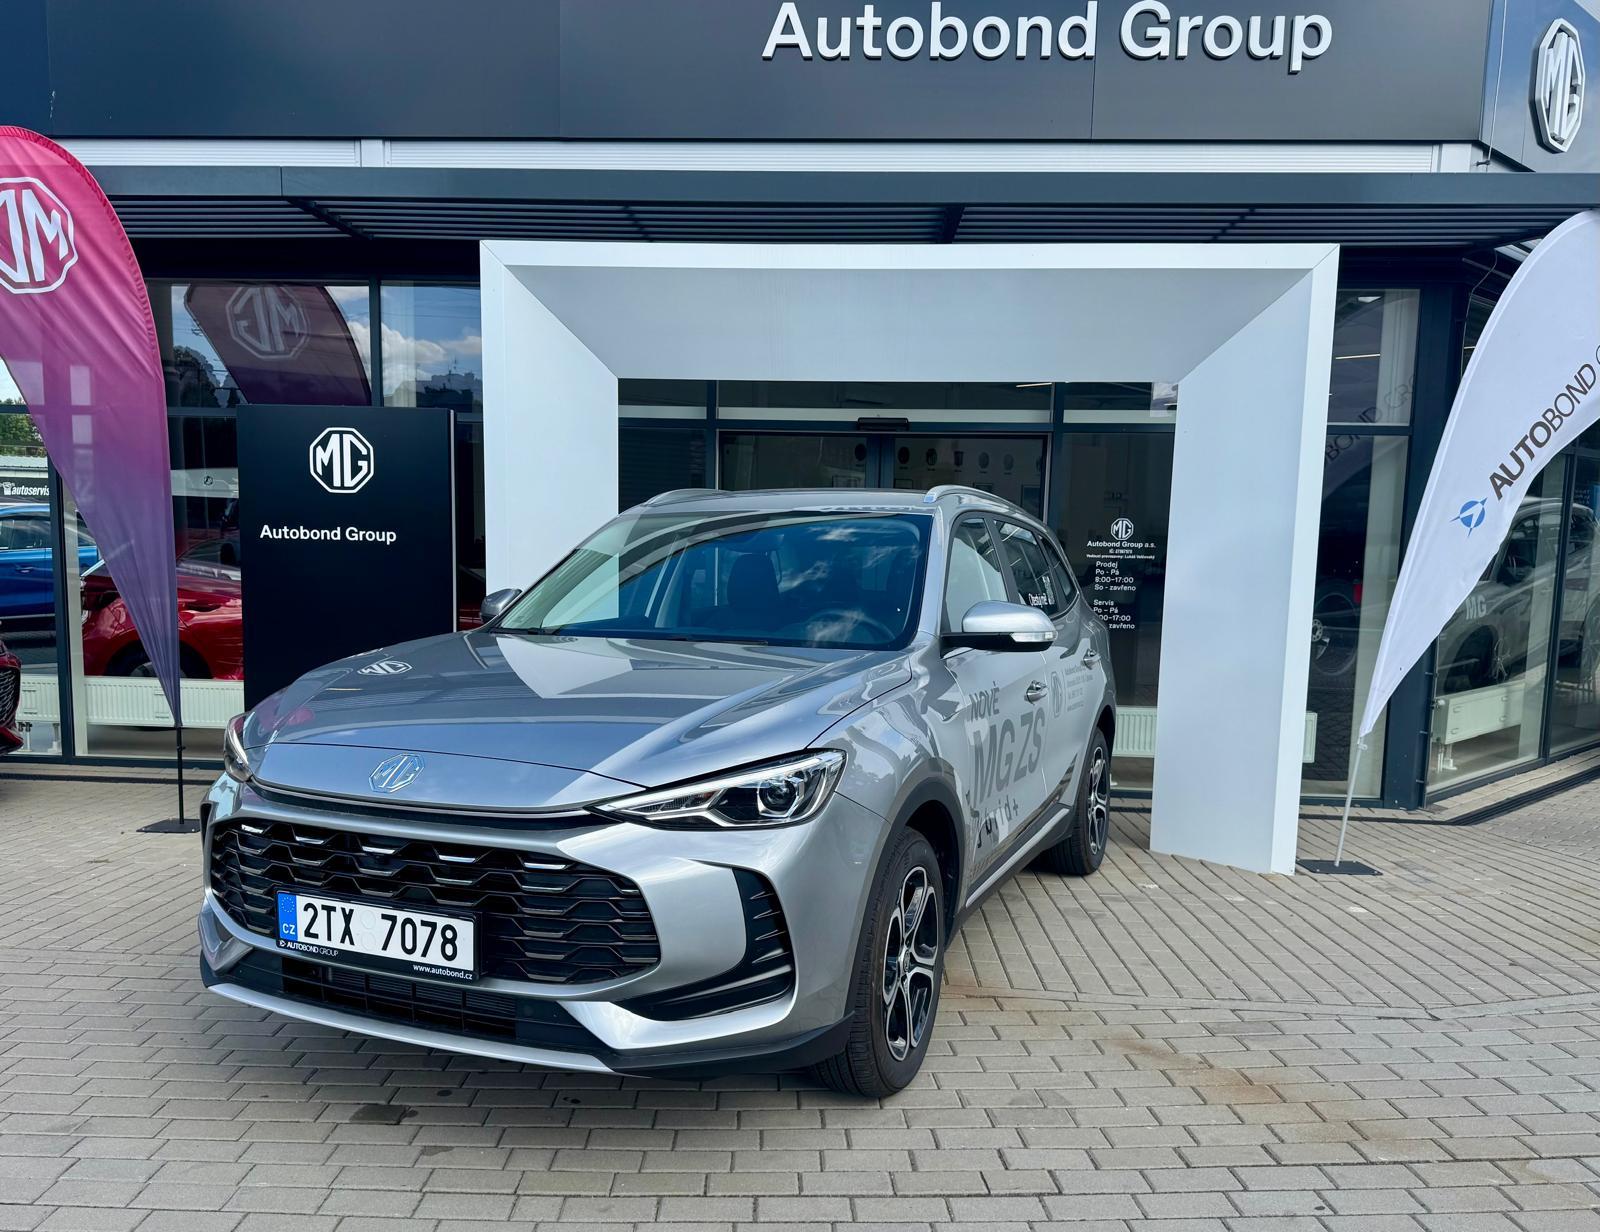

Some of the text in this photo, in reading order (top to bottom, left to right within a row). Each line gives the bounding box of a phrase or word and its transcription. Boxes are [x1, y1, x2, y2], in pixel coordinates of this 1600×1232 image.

[762, 0, 1333, 74] Autobond Group
[1542, 28, 1583, 143] MG
[1488, 363, 1597, 501] AUTOBOND
[314, 433, 370, 488] MG
[11, 484, 50, 496] autoservis
[260, 524, 397, 546] Autobond Group
[1112, 520, 1133, 539] MG
[1086, 540, 1120, 548] Autobond
[1121, 541, 1143, 549] Group
[1096, 561, 1118, 569] Prodej
[1465, 594, 1487, 621] MG
[969, 681, 1000, 723] NOVÉ
[972, 707, 1046, 808] MG ZS
[372, 756, 422, 790] MG
[282, 922, 296, 935] CZ
[303, 902, 458, 962] 2TX 7078
[286, 941, 339, 957] AUTOBOND GROUP
[412, 963, 473, 981] www.autobond.cz
